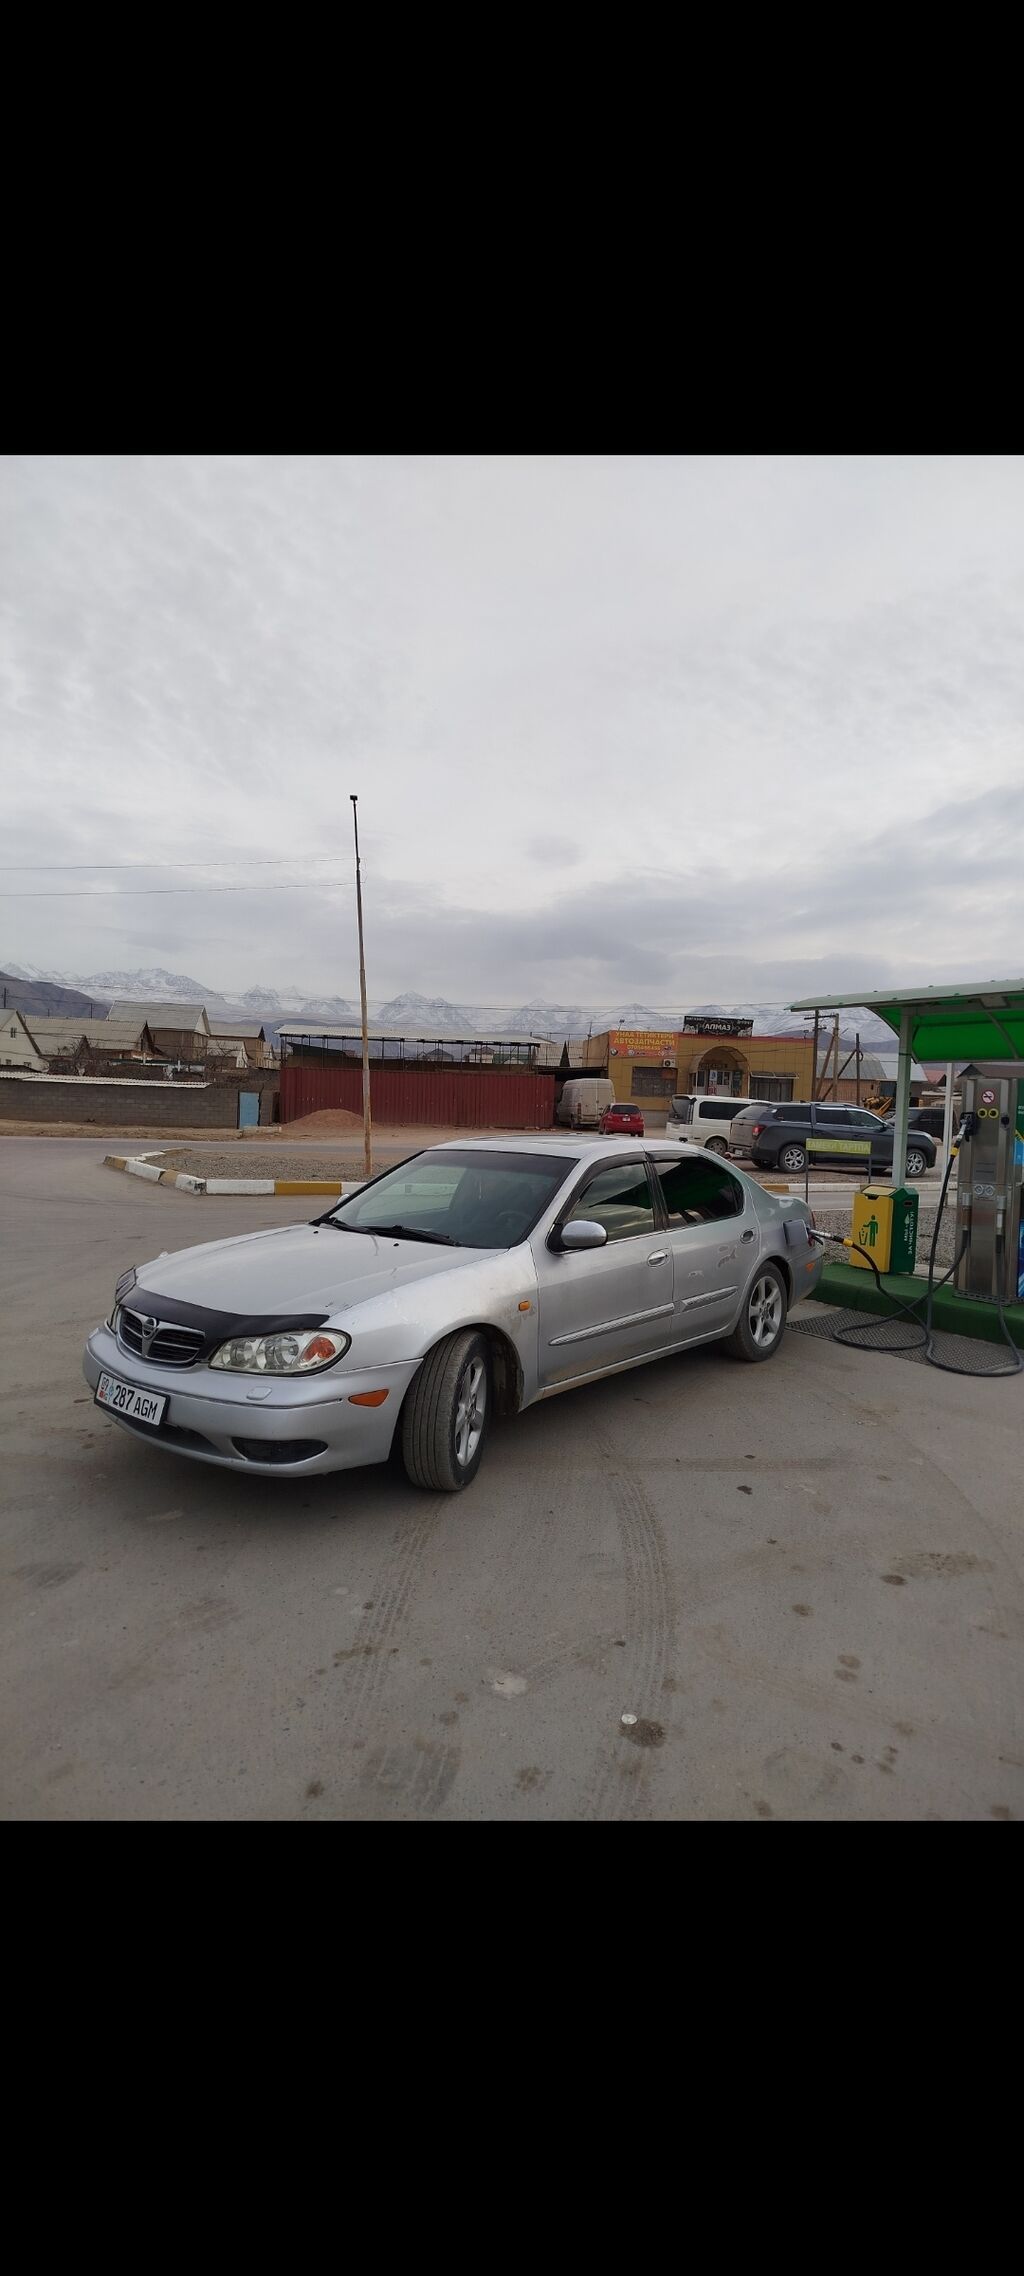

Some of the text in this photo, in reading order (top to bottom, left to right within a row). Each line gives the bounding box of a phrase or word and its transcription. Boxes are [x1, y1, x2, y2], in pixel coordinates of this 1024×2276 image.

[704, 1023, 731, 1031] АЛМАЗ
[613, 1037, 675, 1046] АВТОЗАПЧАСТИ
[113, 1384, 158, 1420] 287 AGM
